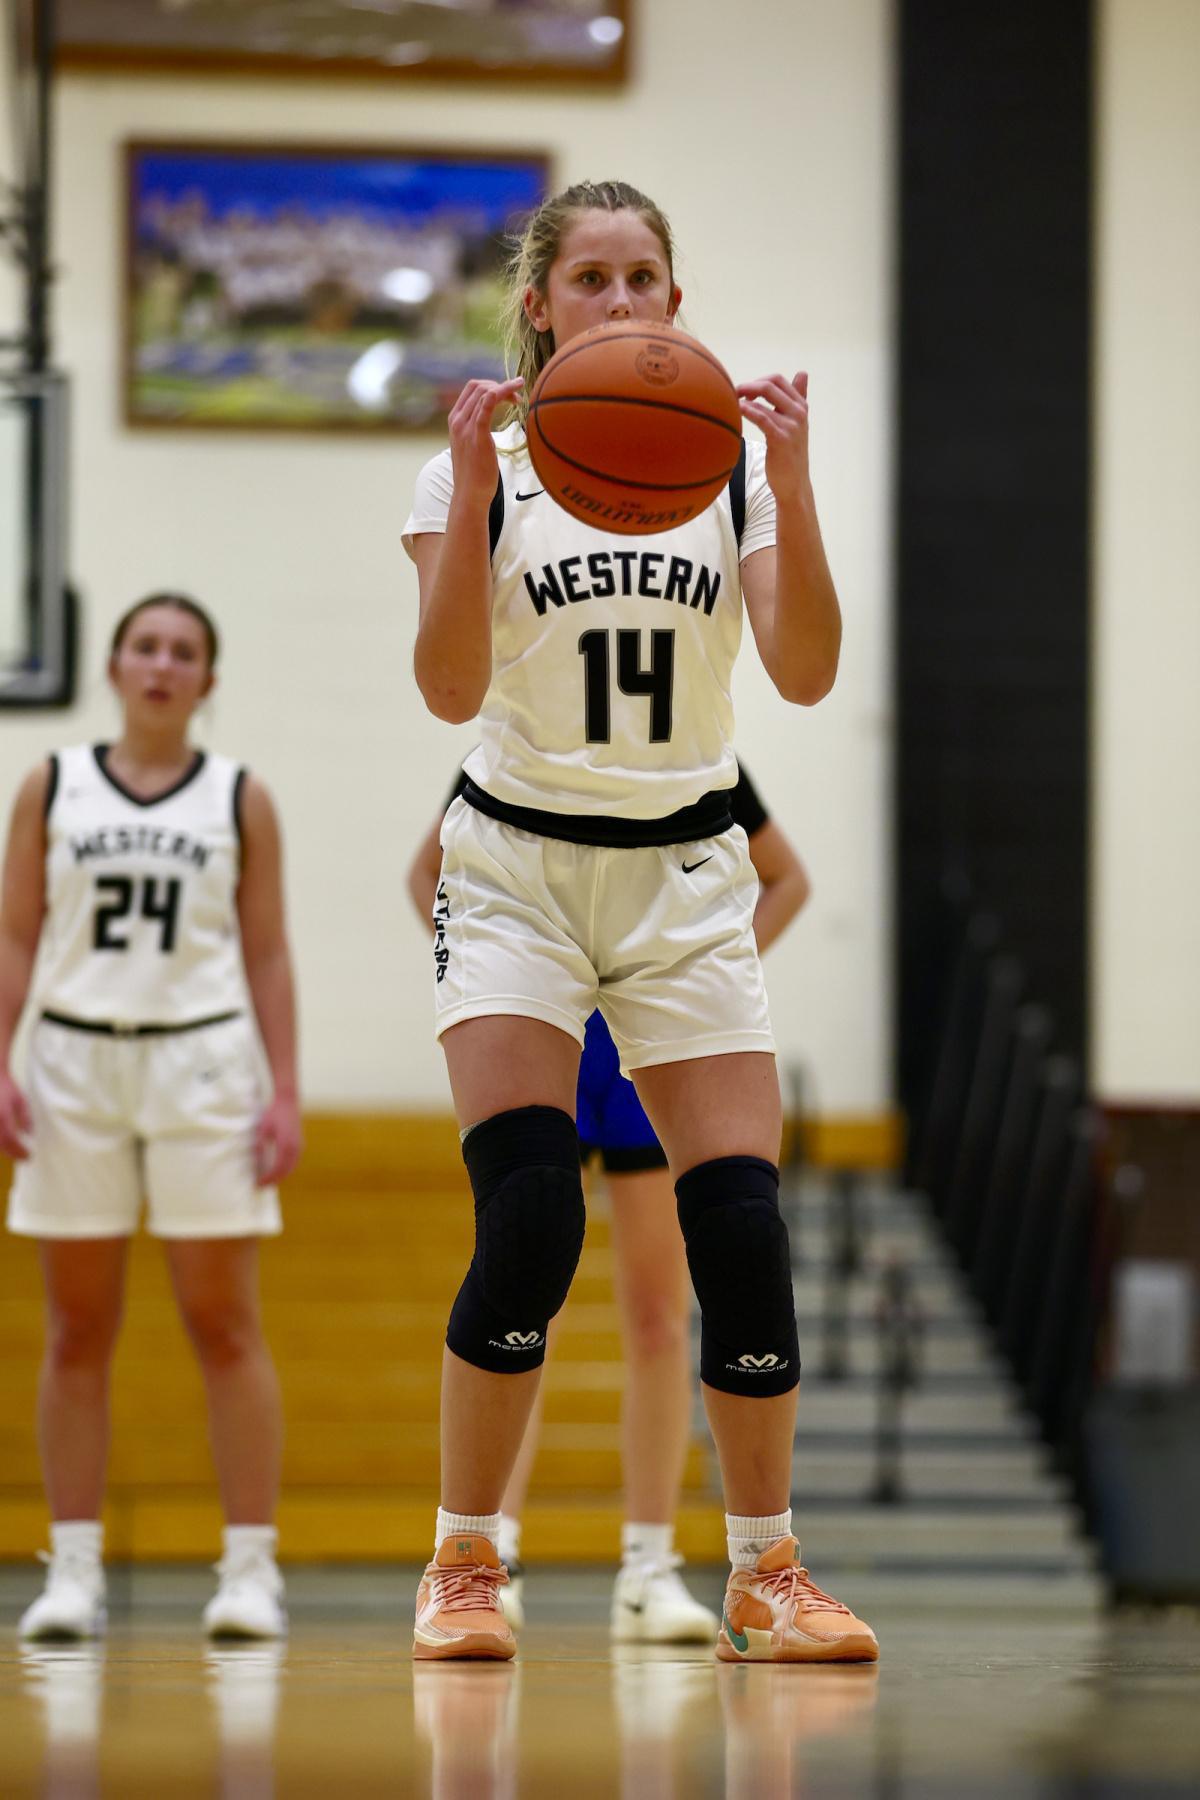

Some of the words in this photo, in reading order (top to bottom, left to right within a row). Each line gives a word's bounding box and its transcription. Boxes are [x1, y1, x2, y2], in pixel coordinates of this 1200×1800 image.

[523, 551, 721, 616] WESTERN
[578, 628, 675, 744] 14
[71, 826, 210, 870] WESTERN
[93, 874, 181, 953] 24
